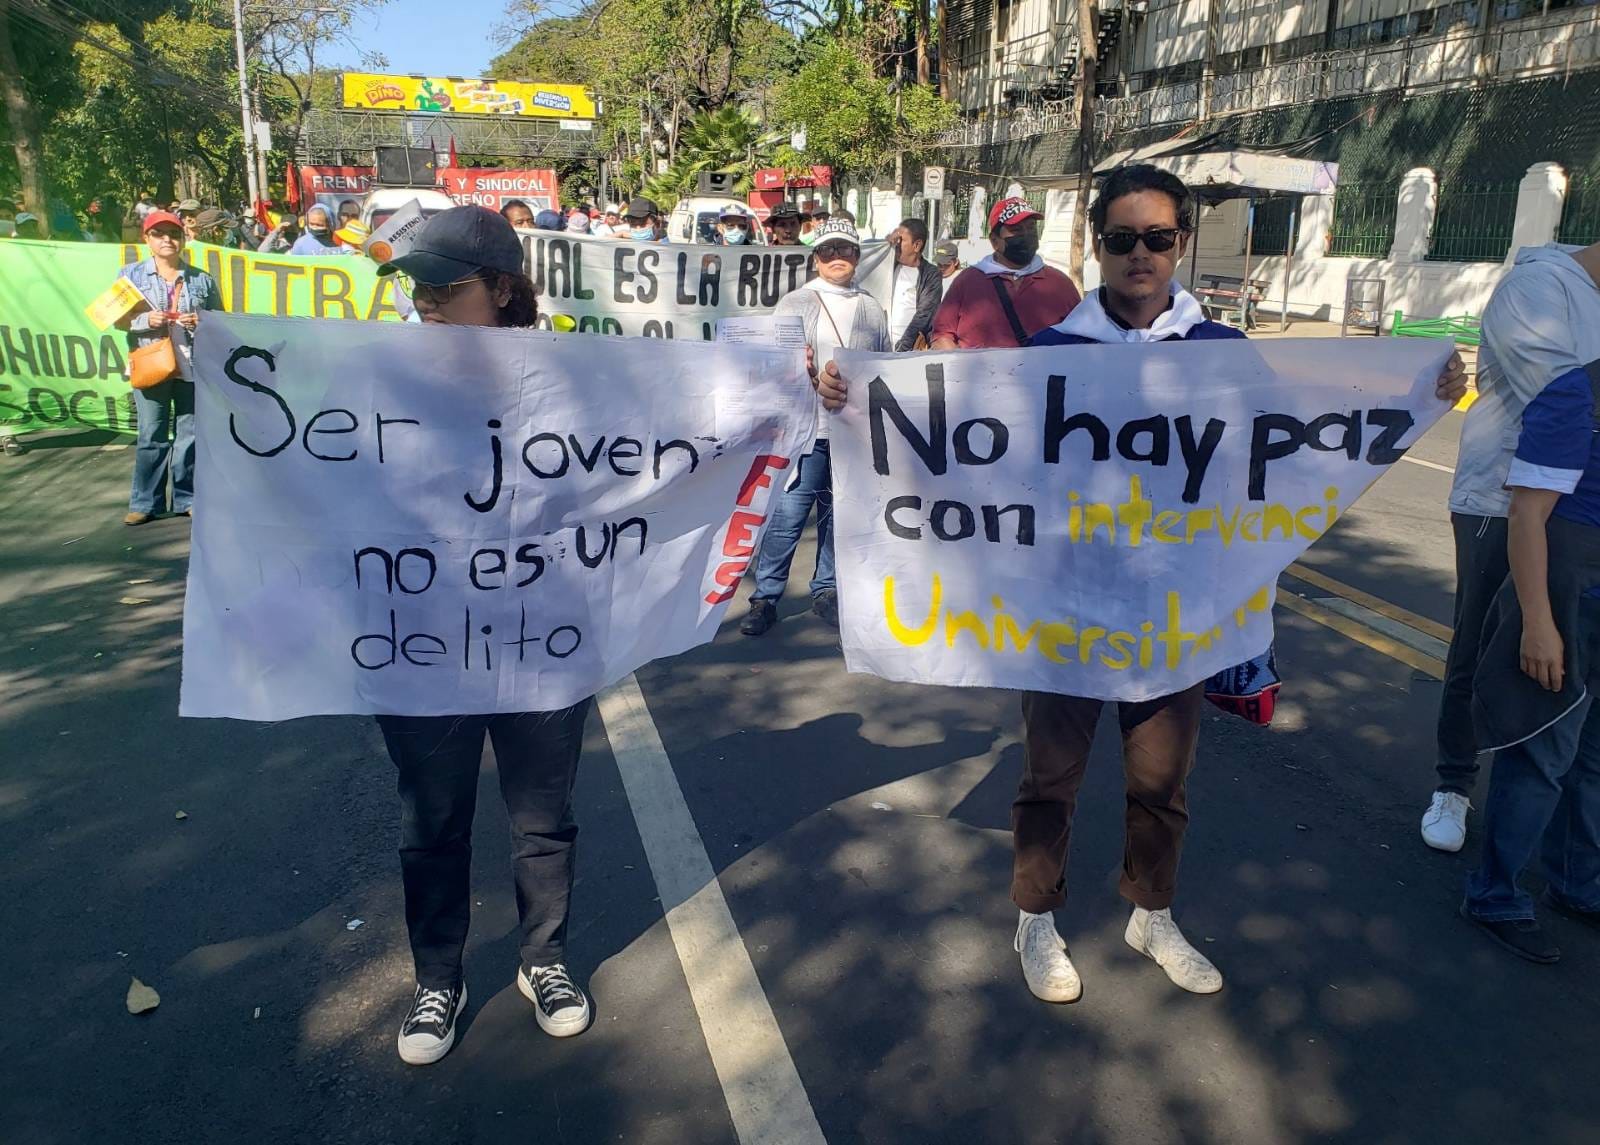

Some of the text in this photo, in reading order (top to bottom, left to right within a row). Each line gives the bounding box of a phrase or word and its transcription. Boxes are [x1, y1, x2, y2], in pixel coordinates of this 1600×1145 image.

[457, 177, 467, 190] Y
[476, 178, 547, 191] SINDICAL
[522, 235, 594, 300] UAL
[613, 247, 658, 305] ES
[676, 252, 721, 306] LA
[224, 345, 700, 513] Ser joven
[868, 363, 1416, 503] No hay paz
[354, 517, 648, 595] no es un
[704, 455, 791, 605] FES
[884, 495, 1036, 546] con
[351, 600, 582, 671] delito
